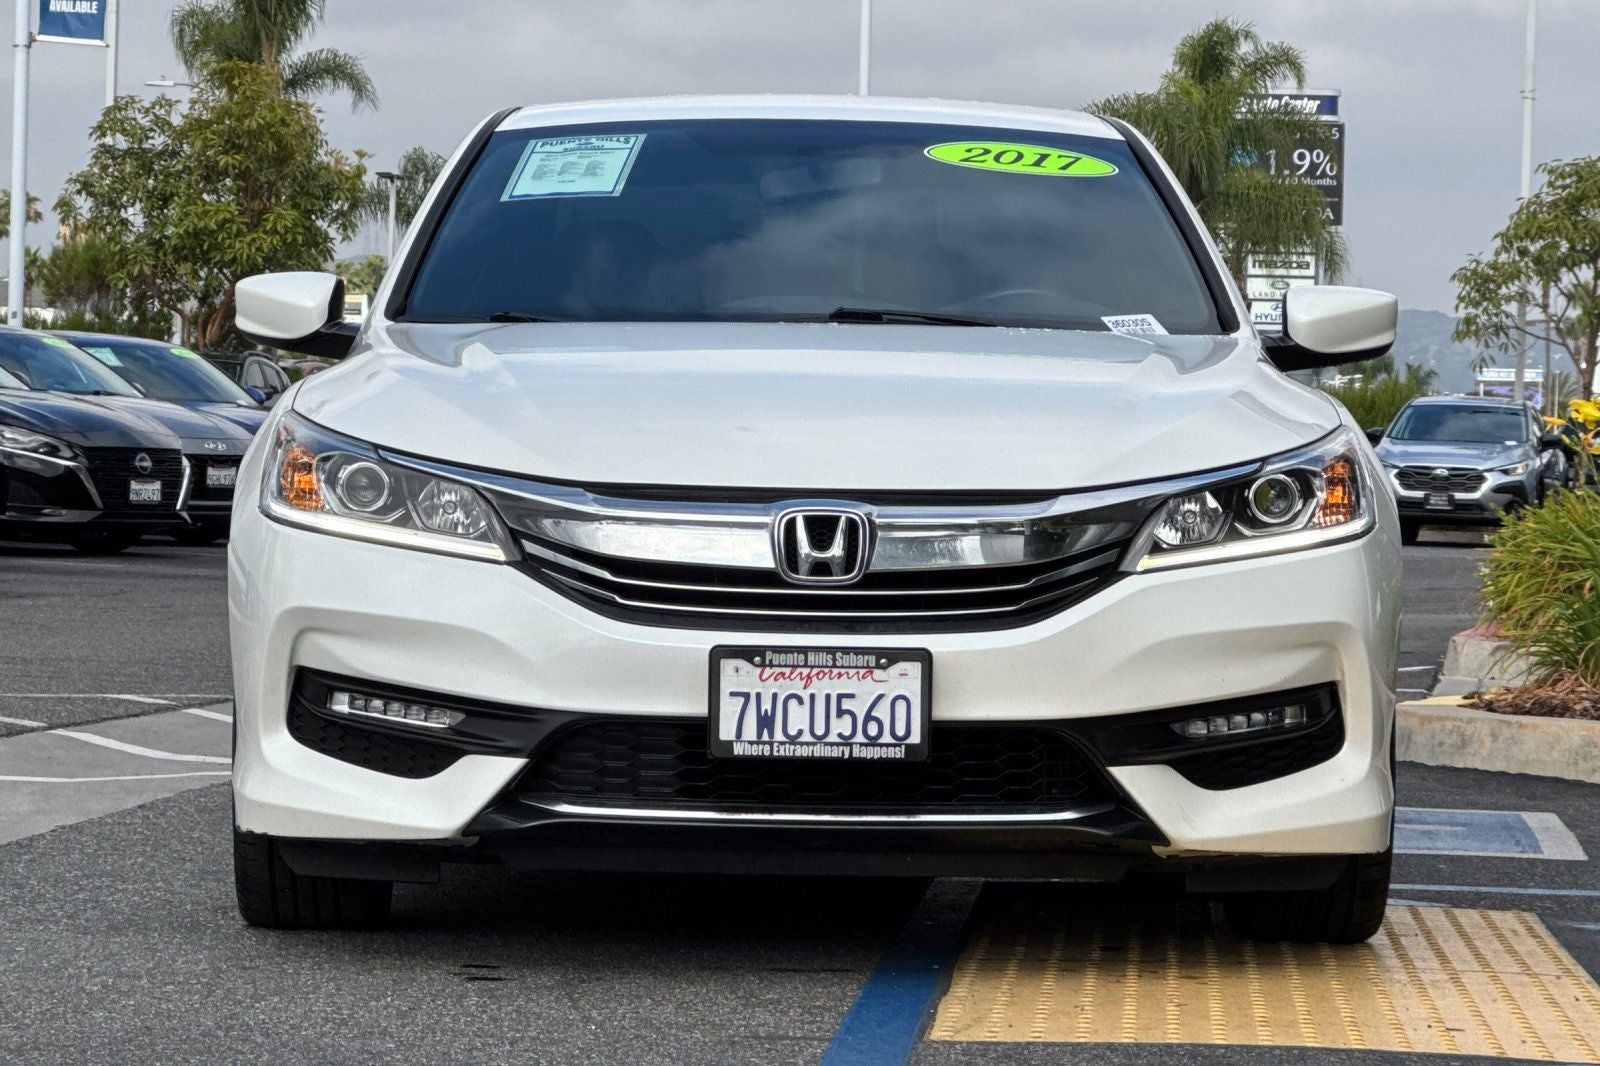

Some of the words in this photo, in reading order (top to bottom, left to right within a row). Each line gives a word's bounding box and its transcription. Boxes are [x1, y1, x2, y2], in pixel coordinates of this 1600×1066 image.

[49, 0, 98, 14] AVAILABLE
[596, 136, 632, 144] HILLS
[958, 147, 1083, 171] 2017
[1301, 177, 1337, 186] Months
[765, 651, 804, 667] Puente
[807, 652, 833, 667] Hills
[835, 653, 876, 667] Subaru
[758, 666, 889, 690] California
[729, 691, 912, 742] 7WCU560
[733, 741, 770, 756] Where
[772, 742, 850, 759] Extraordinary
[852, 744, 905, 759] Happens!
